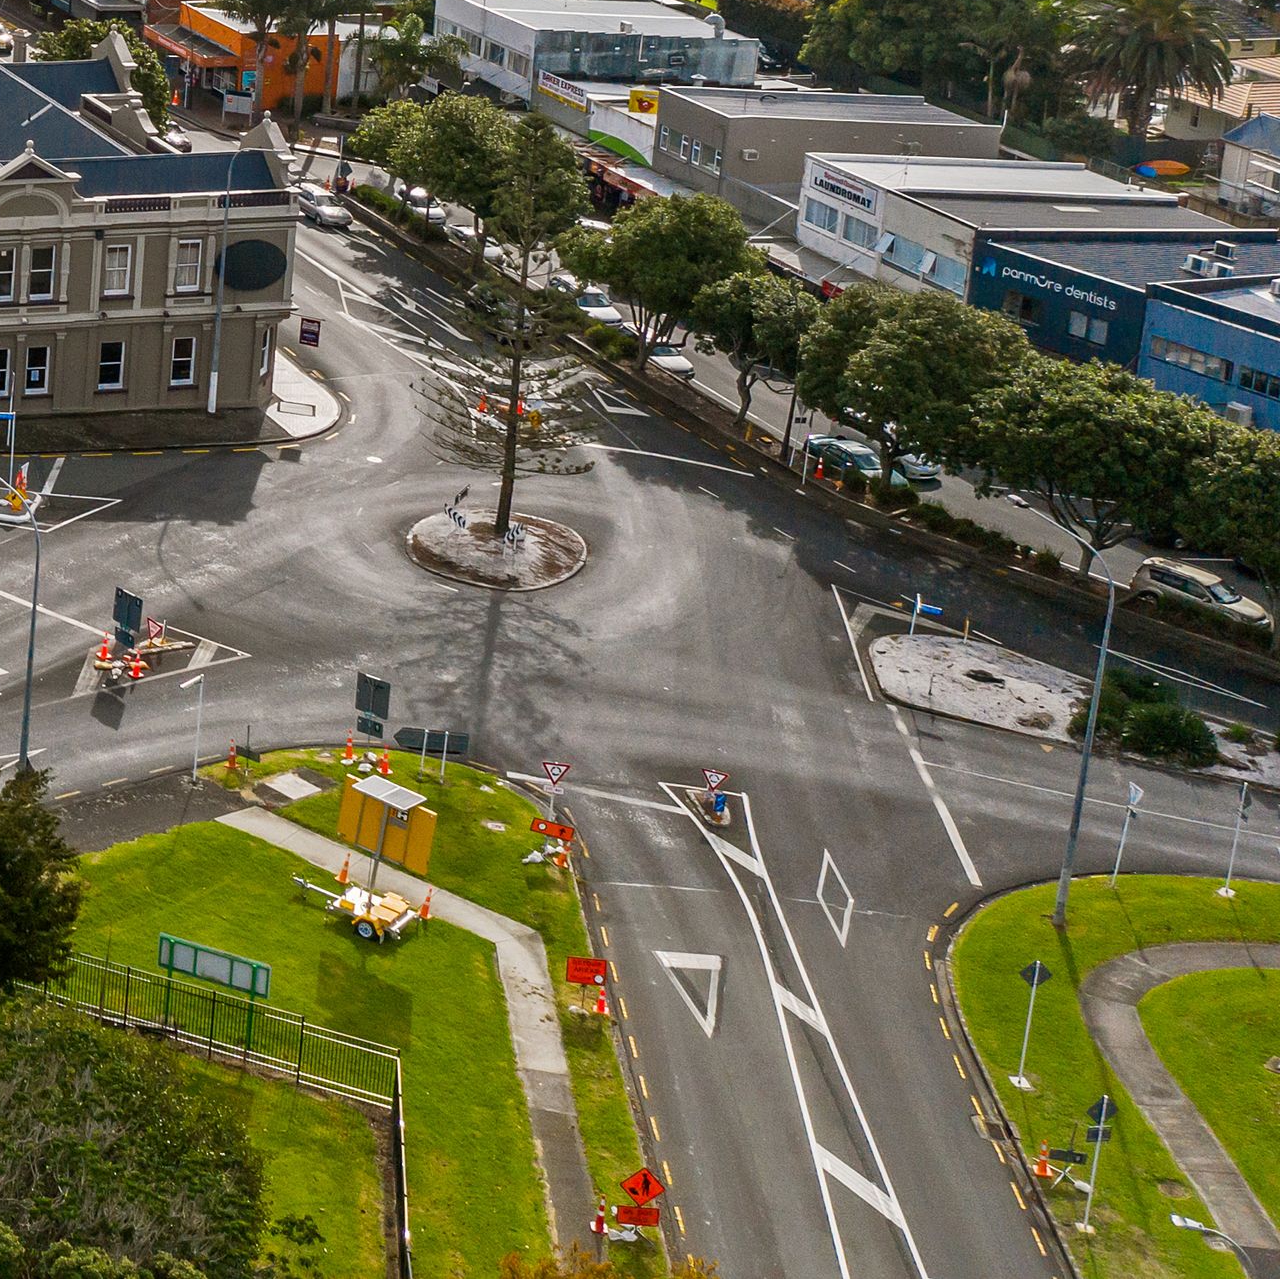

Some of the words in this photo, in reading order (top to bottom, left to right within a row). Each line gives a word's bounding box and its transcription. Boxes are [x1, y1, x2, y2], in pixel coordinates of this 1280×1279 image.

[561, 80, 584, 97] EXPRESS
[814, 176, 872, 208] LAUNDROMAT
[1002, 266, 1062, 292] panmure
[1065, 285, 1117, 310] dentists
